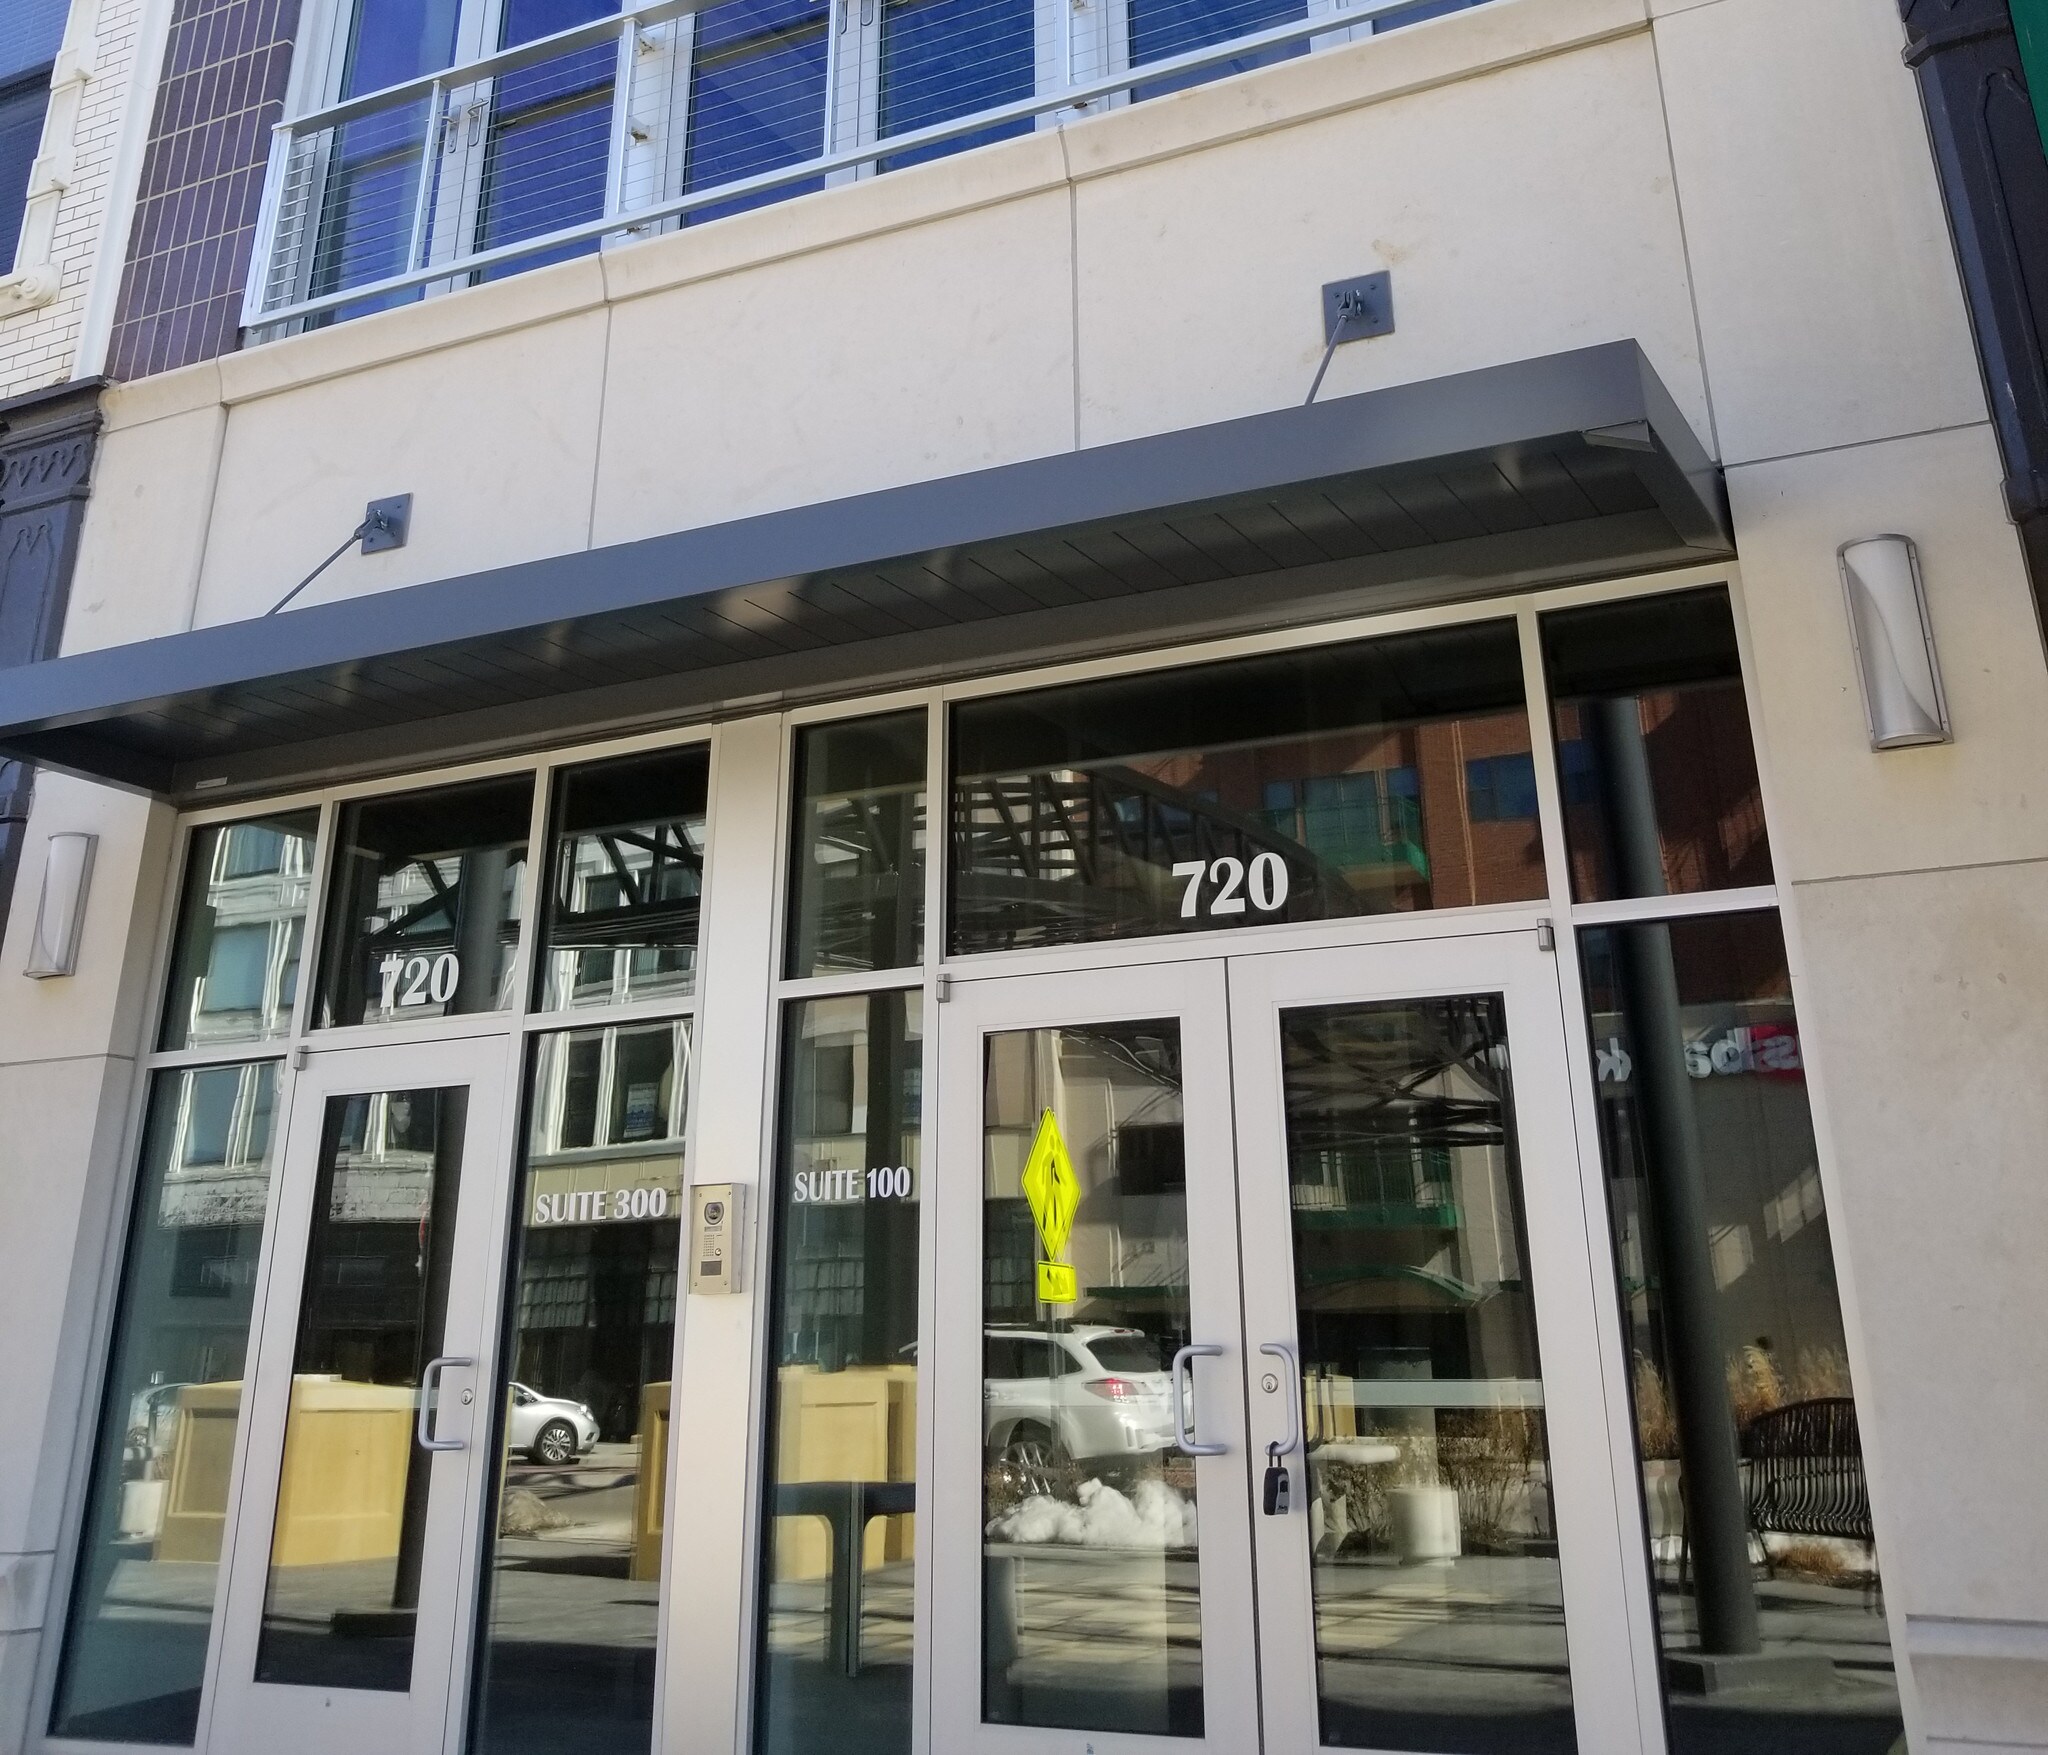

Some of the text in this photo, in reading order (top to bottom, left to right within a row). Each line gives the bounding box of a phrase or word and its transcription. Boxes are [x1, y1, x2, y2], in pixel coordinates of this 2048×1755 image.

[1171, 852, 1289, 918] 720
[378, 952, 460, 1008] 720
[535, 1186, 667, 1223] SUITE 300
[793, 1166, 911, 1202] SUITE 100
